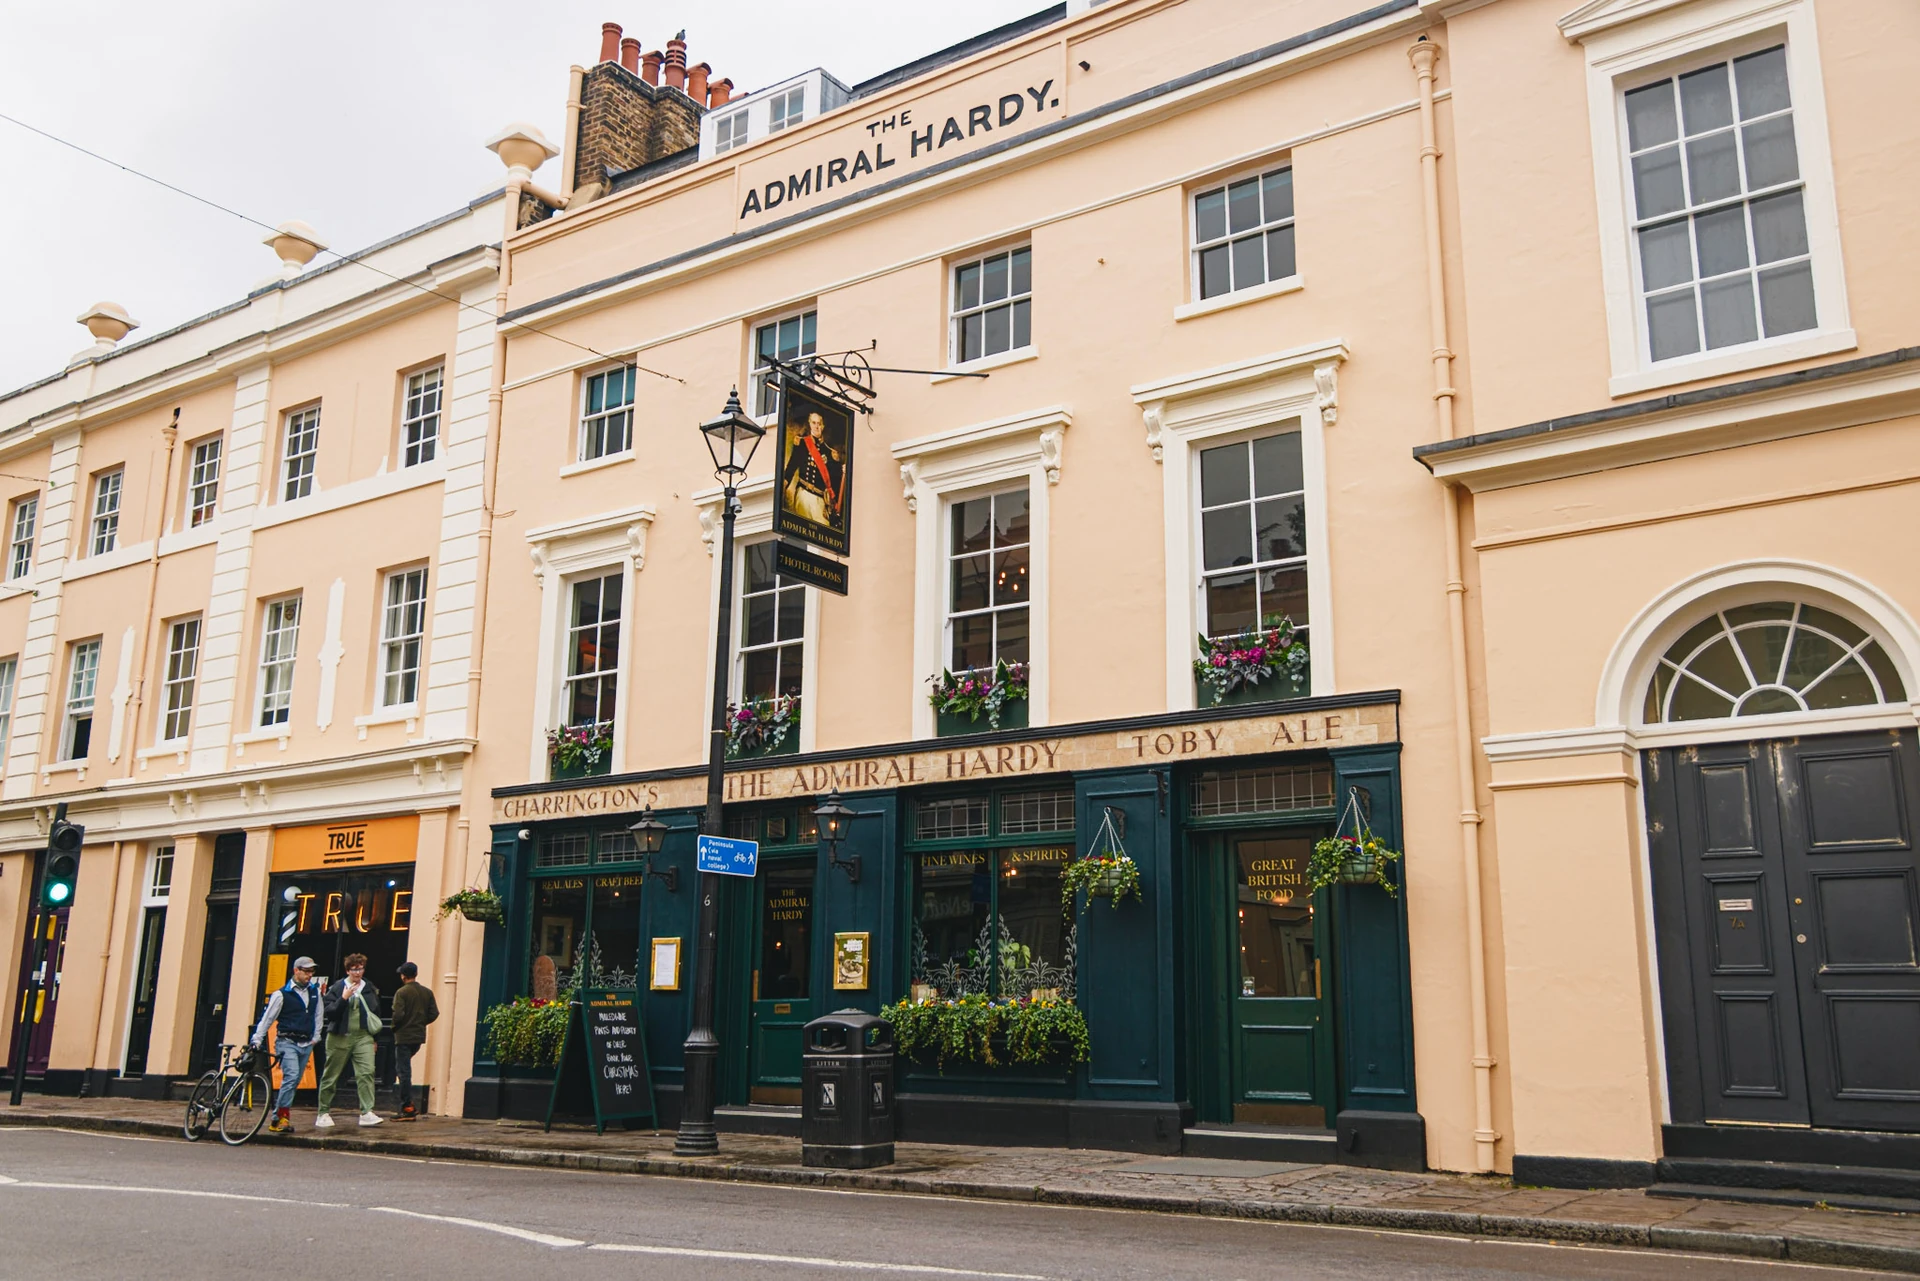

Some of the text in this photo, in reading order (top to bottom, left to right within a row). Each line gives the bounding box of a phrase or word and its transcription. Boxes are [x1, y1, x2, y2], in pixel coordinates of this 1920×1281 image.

[866, 110, 912, 137] THE
[740, 79, 1059, 220] ADMIRAL HARDY.
[781, 520, 844, 549] ADMIRAL HARDY
[780, 554, 842, 583] 7 HOTEL ROOMS
[503, 715, 1343, 818] CHARRINGTON'S THE ADMIRAL HARDY TOBY ALE
[328, 830, 365, 850] TRUE
[708, 840, 734, 848] Peninsula
[921, 848, 1068, 866] FINE WINES & SPIRITS
[1251, 858, 1296, 870] GREAT
[542, 880, 562, 890] REAL
[564, 880, 584, 889] ALES
[595, 876, 623, 887] CRAFT
[1248, 873, 1301, 886] BRITISH
[782, 888, 796, 896] THE
[1256, 889, 1294, 901] FOOD
[704, 894, 710, 906] 6
[768, 898, 810, 908] ADMIRAL
[297, 891, 412, 934] TRUE
[772, 910, 804, 920] HARDY
[604, 1064, 639, 1080] CHRISTMAS
